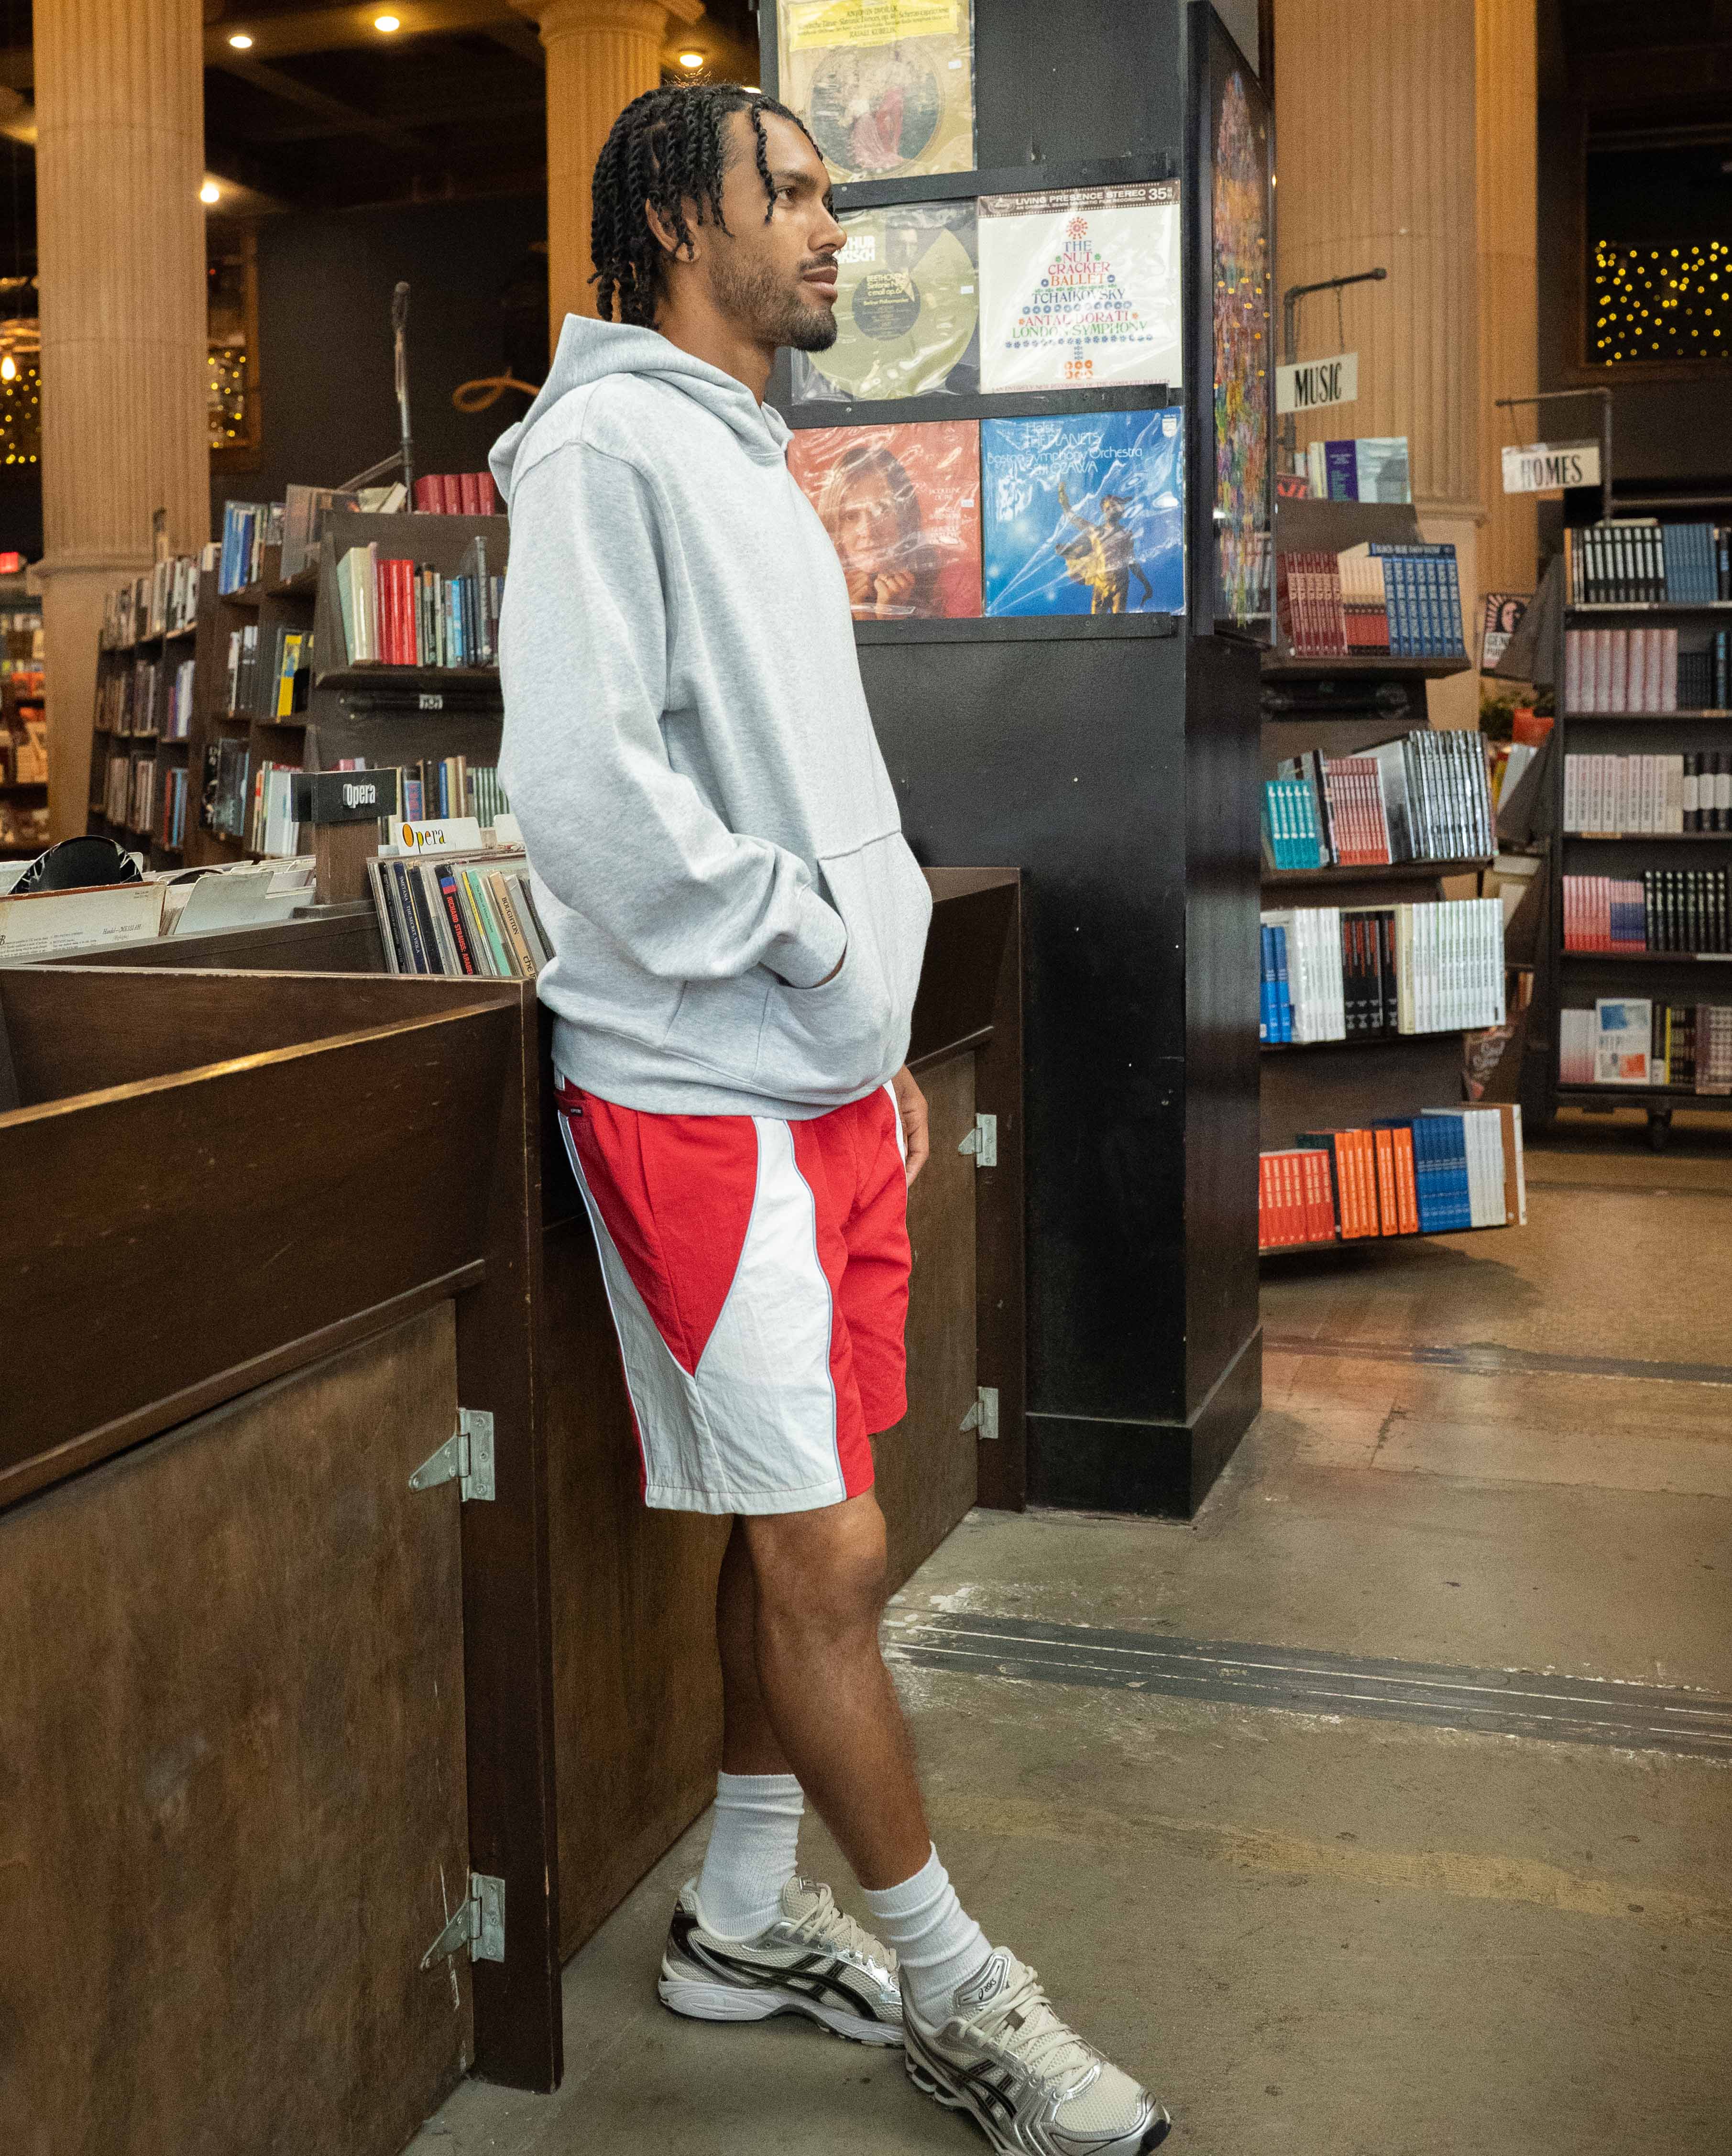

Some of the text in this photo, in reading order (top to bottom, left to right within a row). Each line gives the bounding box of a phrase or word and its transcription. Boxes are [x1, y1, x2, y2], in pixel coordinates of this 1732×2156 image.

[1016, 196, 1047, 205] LIVING
[1049, 192, 1104, 203] PRESENCE
[1105, 189, 1146, 199] STEREO
[1148, 187, 1167, 200] 35
[1063, 240, 1092, 252] THE
[1063, 252, 1093, 263] NUT
[1048, 262, 1110, 275] CRACKER
[1051, 273, 1105, 286] BALLET
[1026, 314, 1070, 327] ANTAL
[1012, 321, 1148, 339] LONDO SYMPHONY
[1295, 362, 1342, 408] MUSIC
[1025, 450, 1088, 465] Symphony
[1089, 447, 1142, 460] Orchestra
[1050, 460, 1098, 475] OZAWA
[1521, 455, 1583, 490] HOMES
[344, 783, 376, 809] Opera
[403, 823, 446, 854] Opera
[399, 876, 408, 901] SMETANA
[447, 896, 459, 923] RICHARD
[454, 923, 466, 952] STRAUSS:
[502, 897, 519, 935] BOUGHTON
